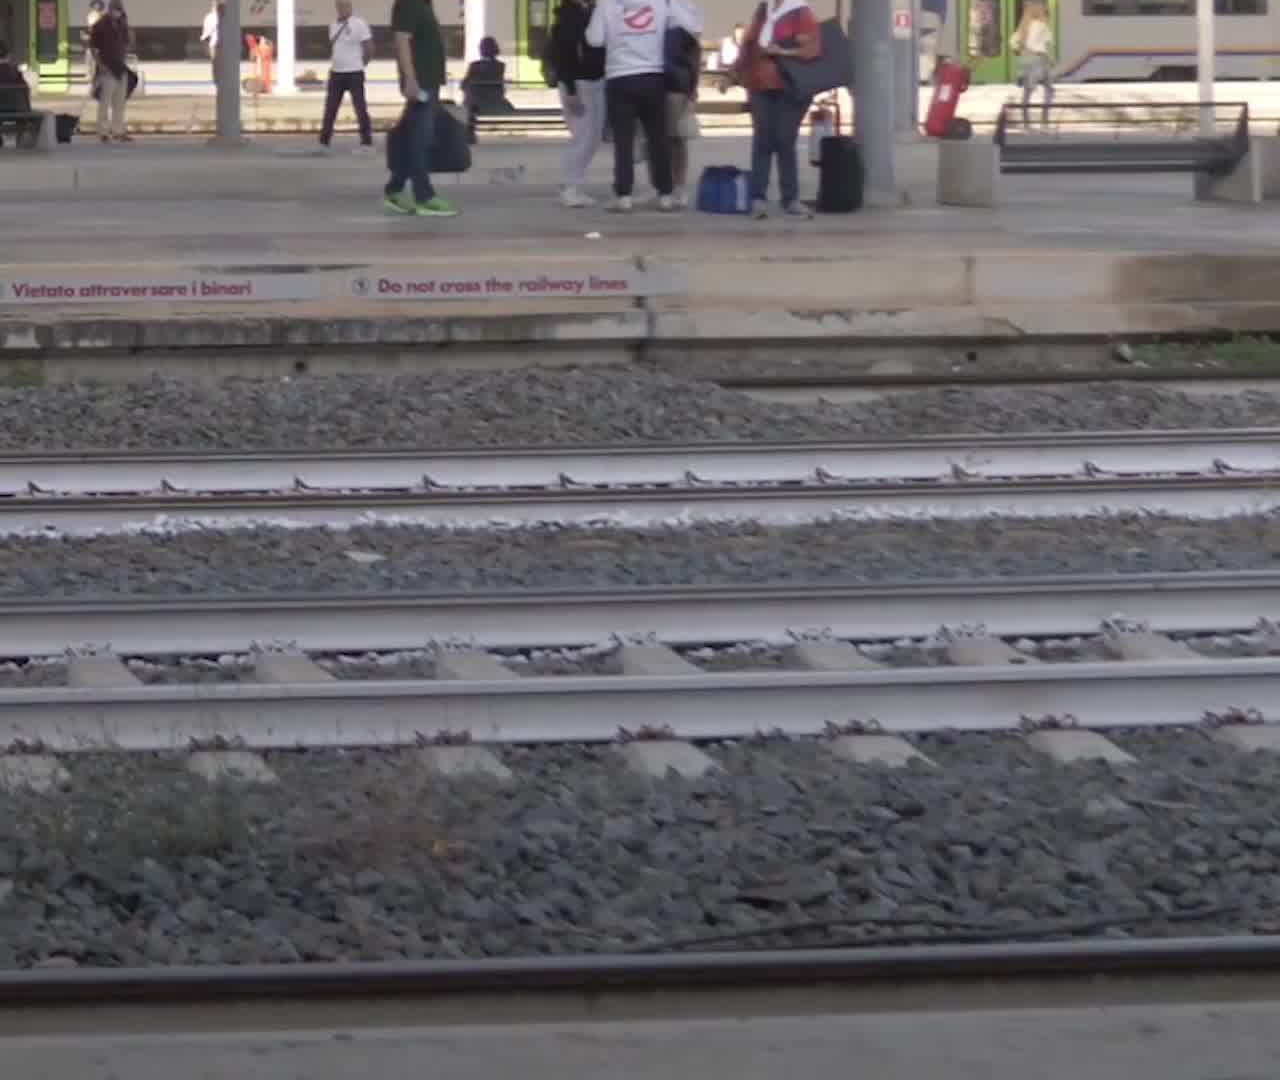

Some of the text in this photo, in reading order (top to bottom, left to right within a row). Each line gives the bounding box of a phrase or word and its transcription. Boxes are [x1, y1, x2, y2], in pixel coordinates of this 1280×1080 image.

[11, 279, 252, 298] Vietato attraversare i binari
[377, 276, 628, 295] Do not cross the railway lines
